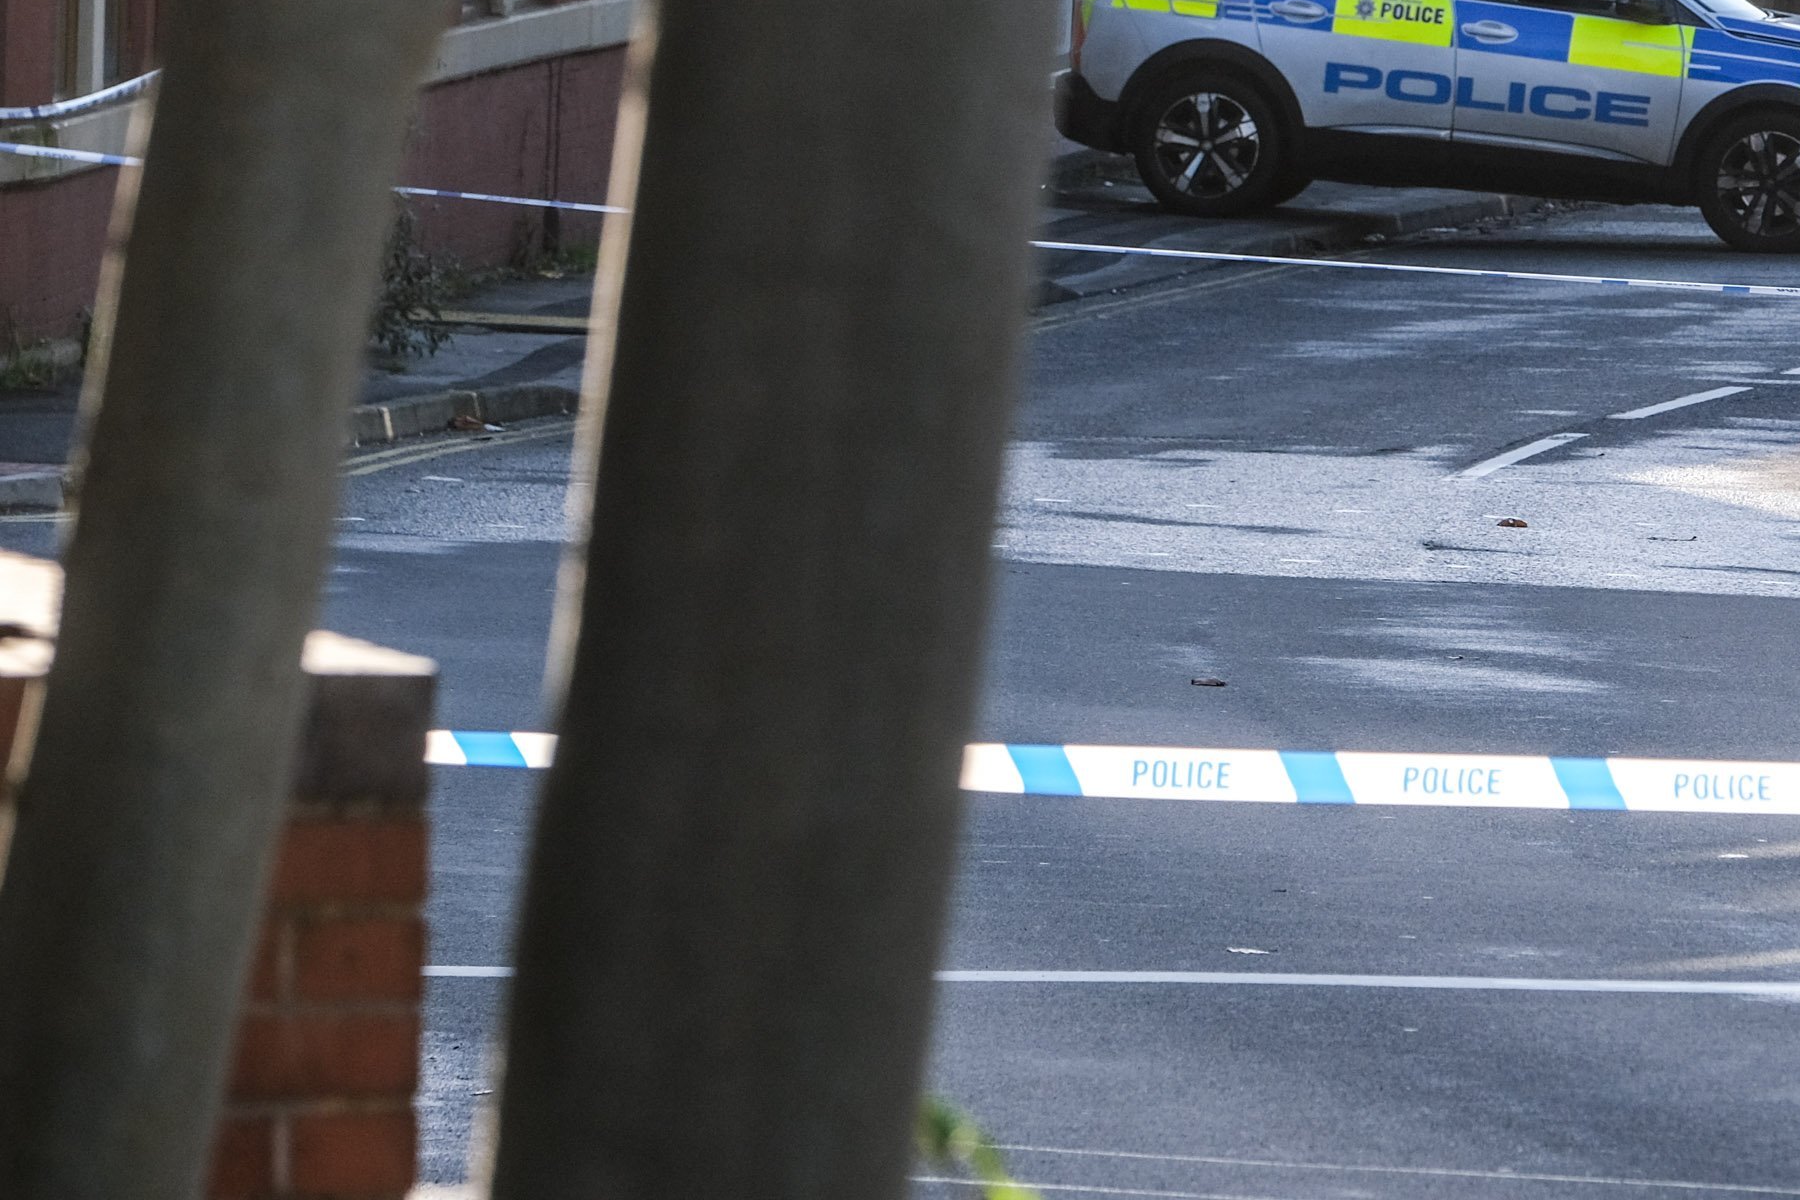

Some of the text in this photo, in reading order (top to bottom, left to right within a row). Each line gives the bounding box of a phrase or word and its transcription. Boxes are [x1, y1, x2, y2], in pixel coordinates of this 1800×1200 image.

[1381, 2, 1444, 24] POLICE
[1324, 62, 1651, 127] POLICE
[1131, 759, 1230, 790] POLICE
[1403, 766, 1502, 795] POLICE
[1673, 773, 1772, 801] POLICE
